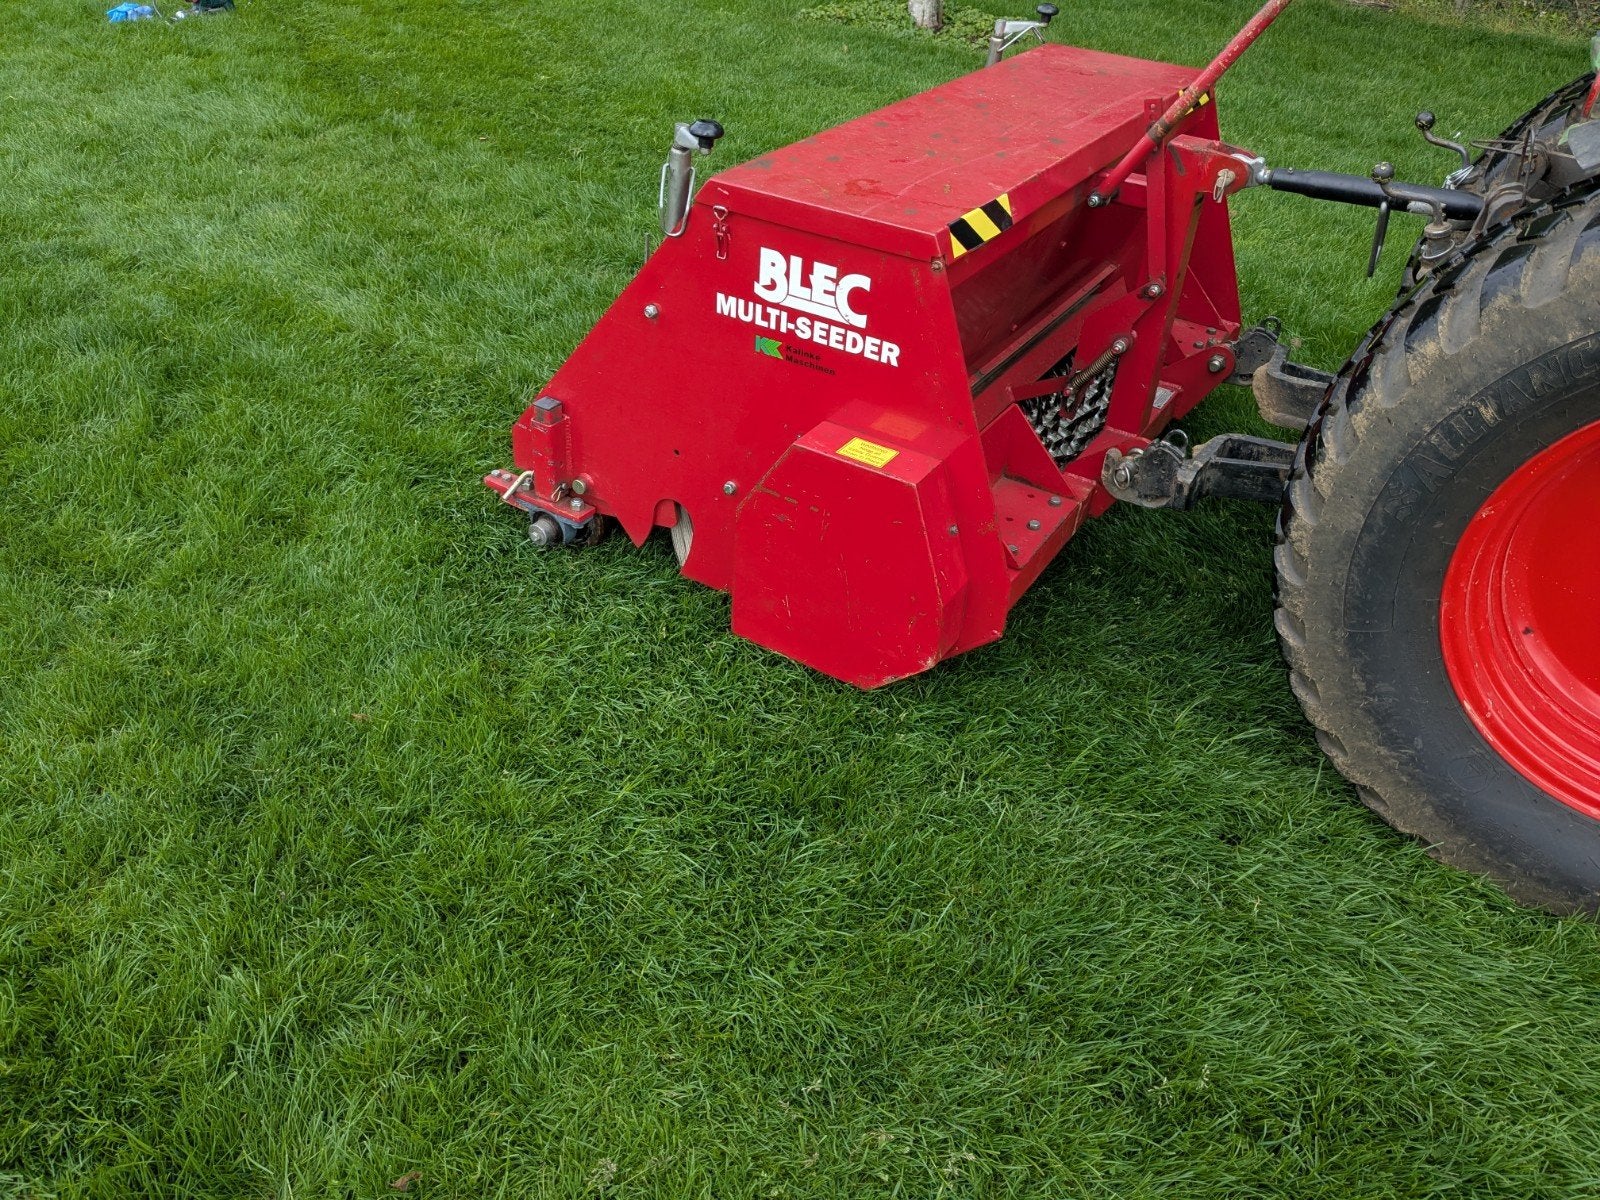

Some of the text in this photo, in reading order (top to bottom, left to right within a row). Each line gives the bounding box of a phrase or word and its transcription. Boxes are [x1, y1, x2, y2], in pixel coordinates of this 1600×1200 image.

[754, 246, 871, 328] BLEC
[716, 292, 901, 367] MULTI-SEEDER
[785, 344, 822, 362] Kalinke
[785, 354, 836, 376] Maschinen
